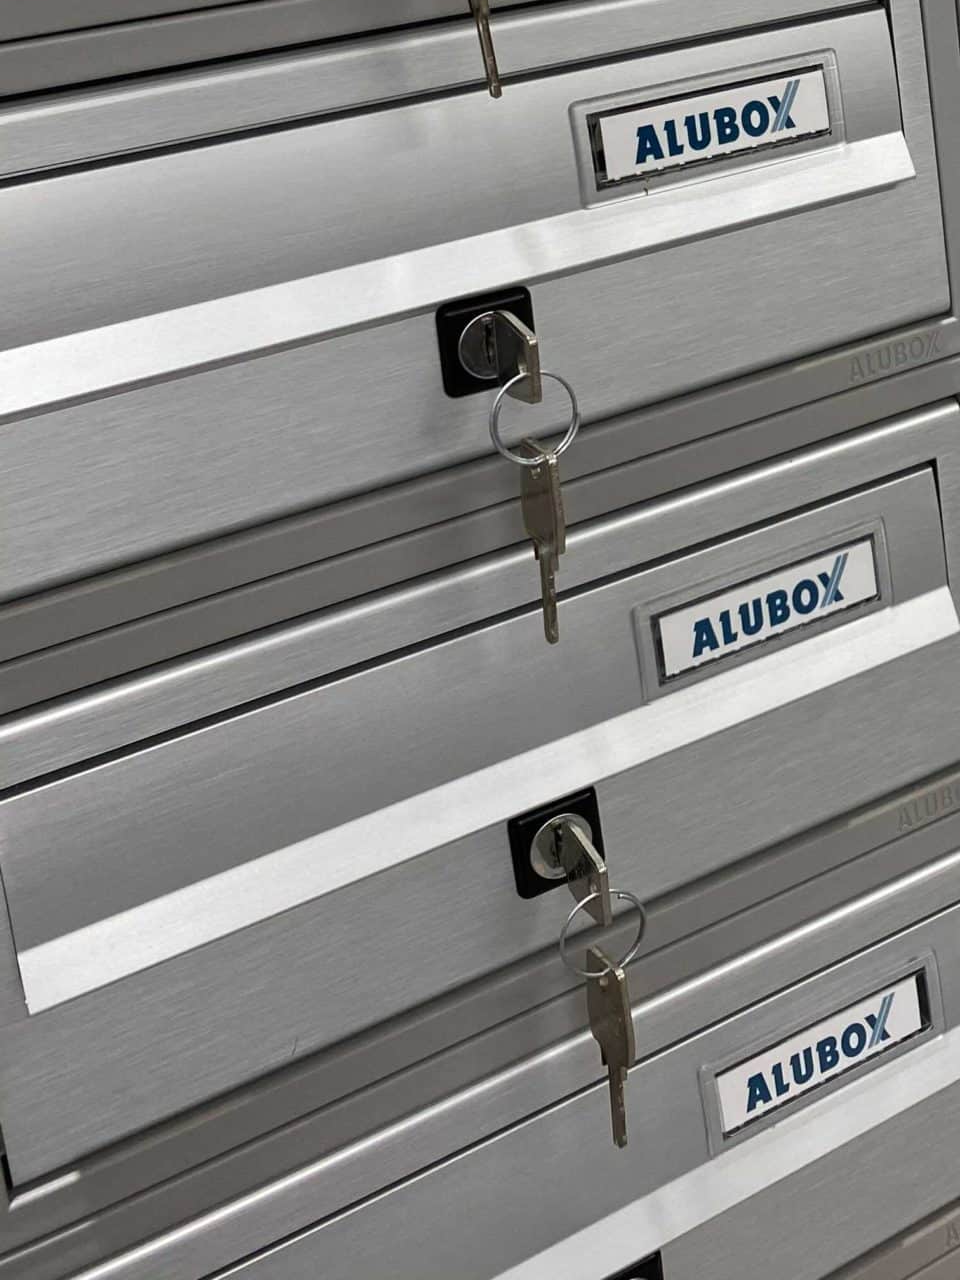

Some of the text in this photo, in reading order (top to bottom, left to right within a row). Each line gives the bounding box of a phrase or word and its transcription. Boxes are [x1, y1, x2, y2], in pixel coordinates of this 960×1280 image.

[635, 79, 799, 164] ALUBOX
[848, 330, 943, 384] ALUBOX
[692, 553, 848, 658] ALUBOX
[746, 994, 894, 1113] ALUBOX
